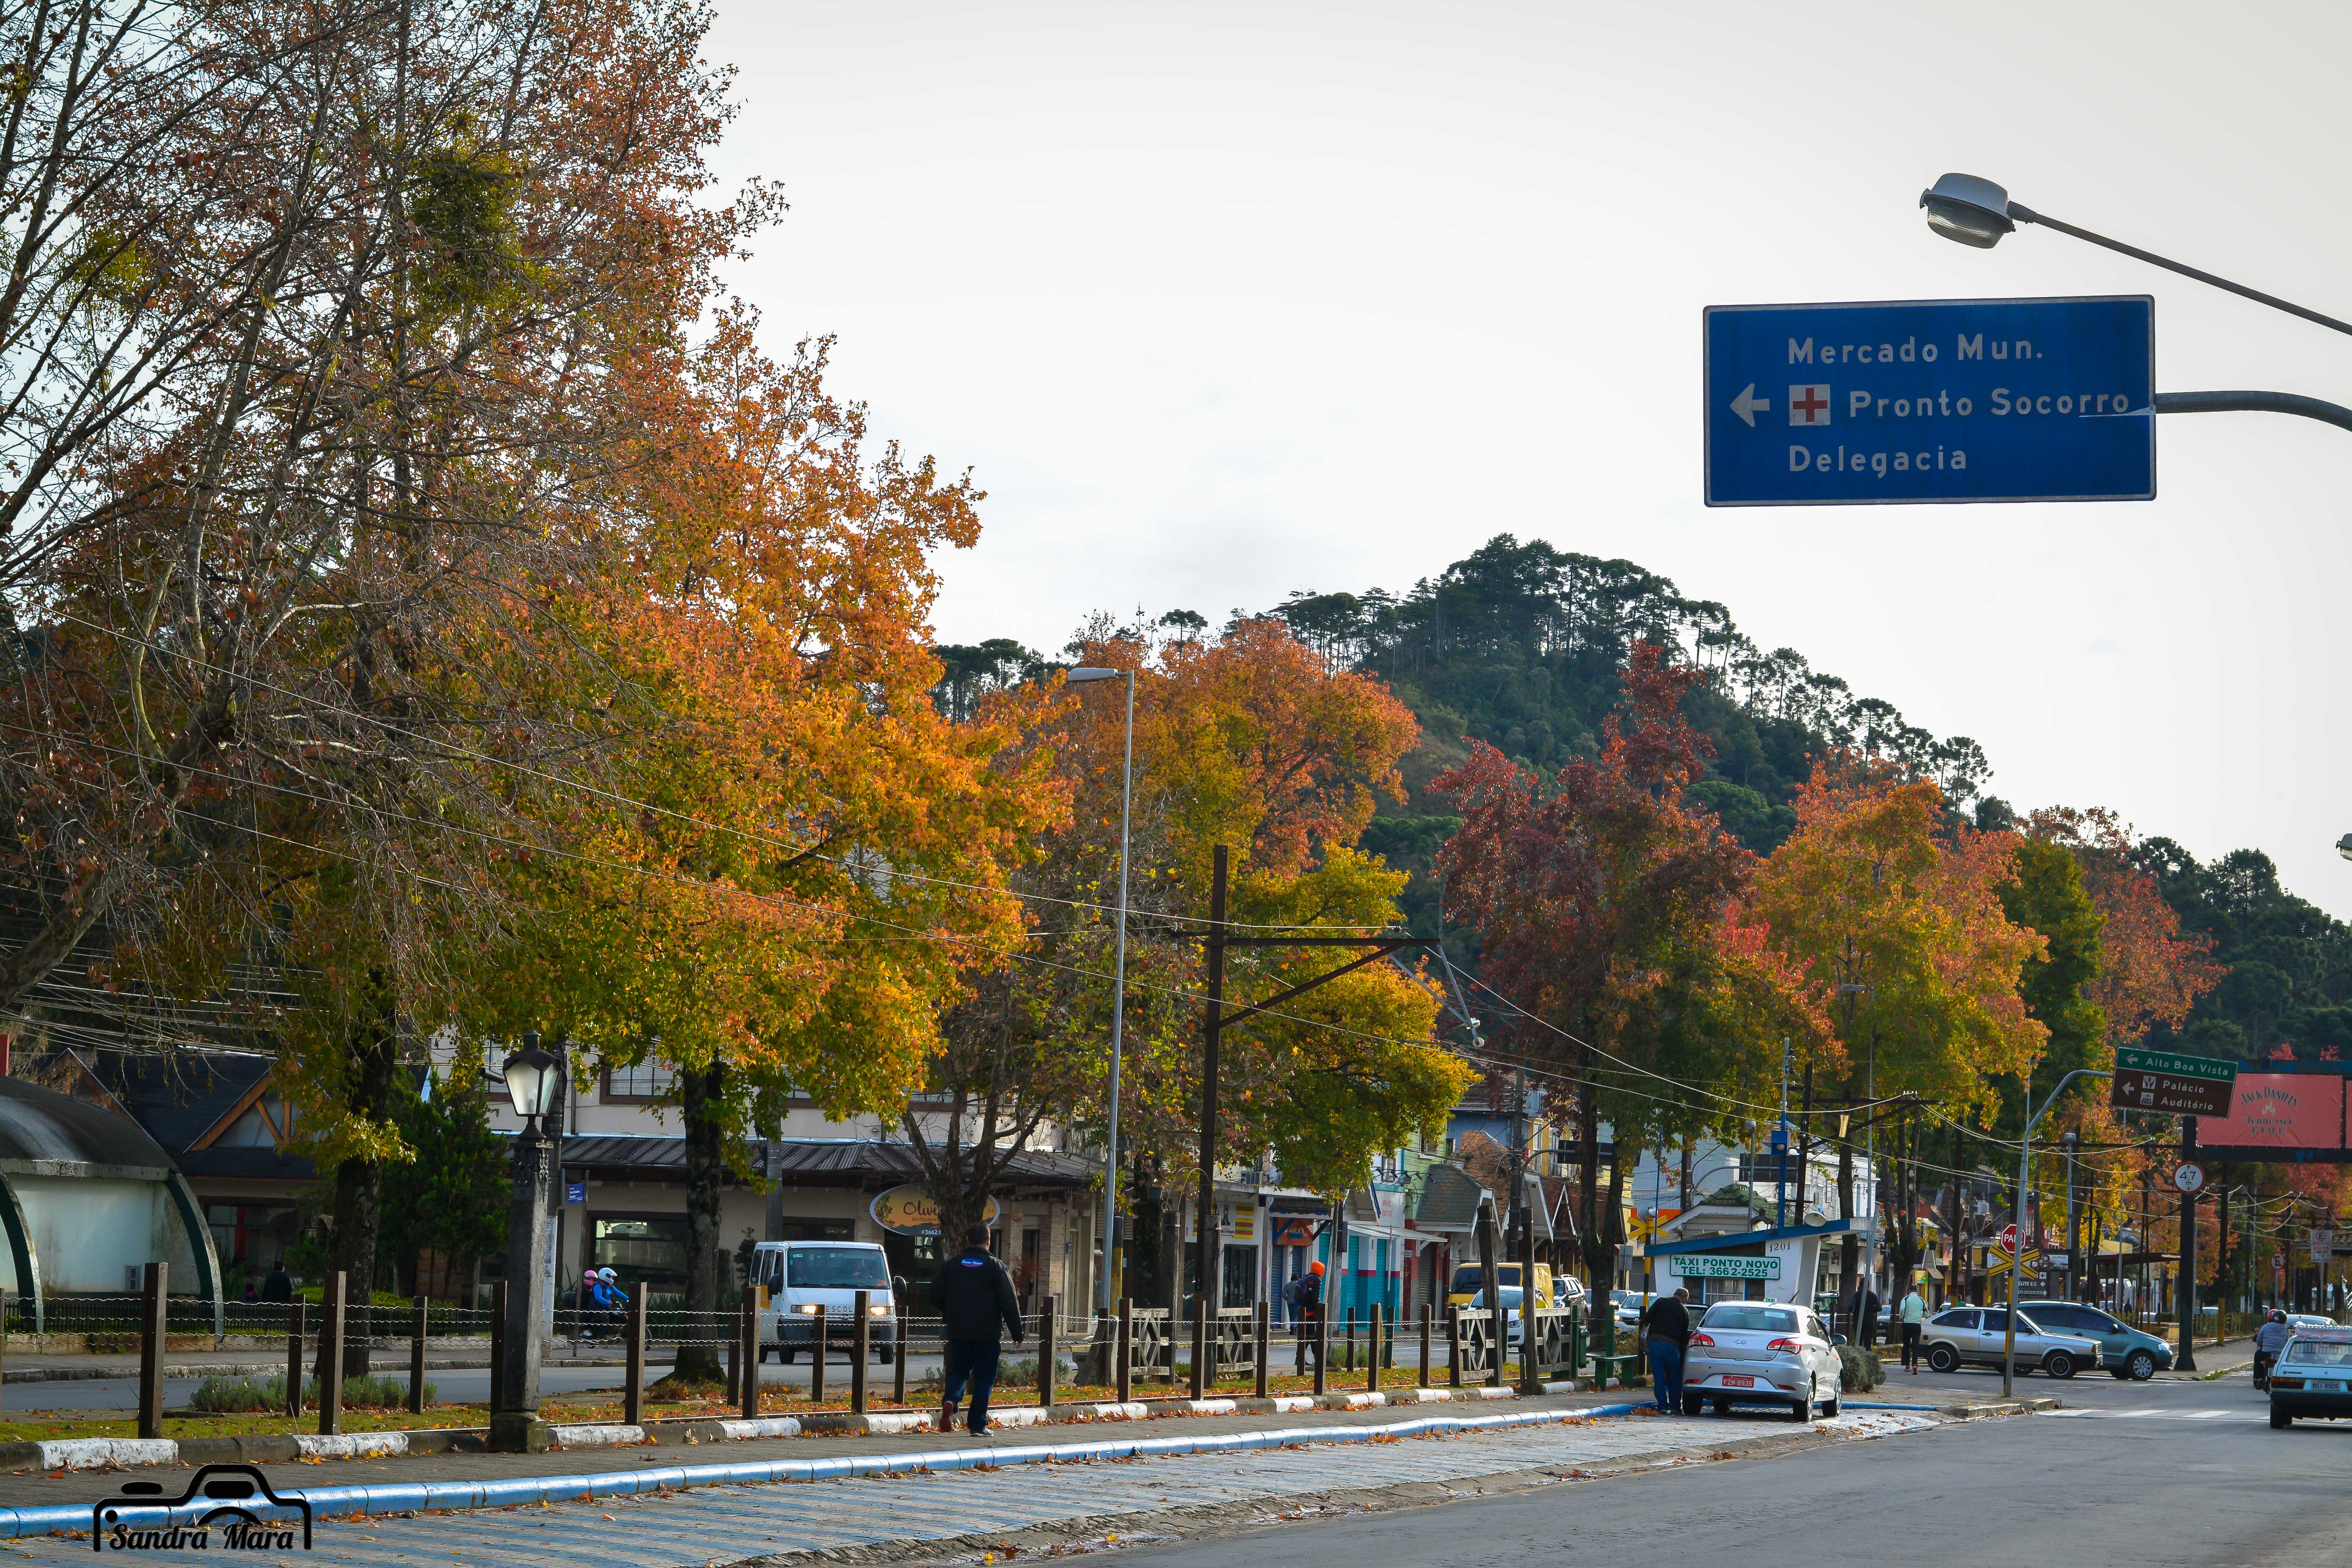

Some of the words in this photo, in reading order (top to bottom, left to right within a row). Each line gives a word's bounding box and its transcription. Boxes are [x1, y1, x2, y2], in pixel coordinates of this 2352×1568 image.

[1789, 336, 1939, 364] Mercado
[1958, 334, 2043, 360] Mun.
[1850, 389, 1973, 418] Pronto
[1991, 388, 2129, 416] Socorro
[1789, 444, 1967, 479] Delegacia
[2145, 1058, 2169, 1068] Alto
[2174, 1061, 2194, 1071] Boa
[2200, 1064, 2228, 1076] Vista
[2163, 1080, 2204, 1093] Palácio
[2161, 1097, 2213, 1110] Auditório
[2241, 1089, 2263, 1106] JACK
[2243, 1113, 2294, 1125] Tennessee
[903, 1200, 938, 1216] Olive
[2004, 1234, 2023, 1243] PA
[1769, 1241, 1791, 1252] 1201
[1673, 1256, 1699, 1266] TÁXI
[1703, 1258, 1742, 1267] PONTO
[1746, 1259, 1778, 1269] NOVO
[1681, 1266, 1705, 1274] TEL:
